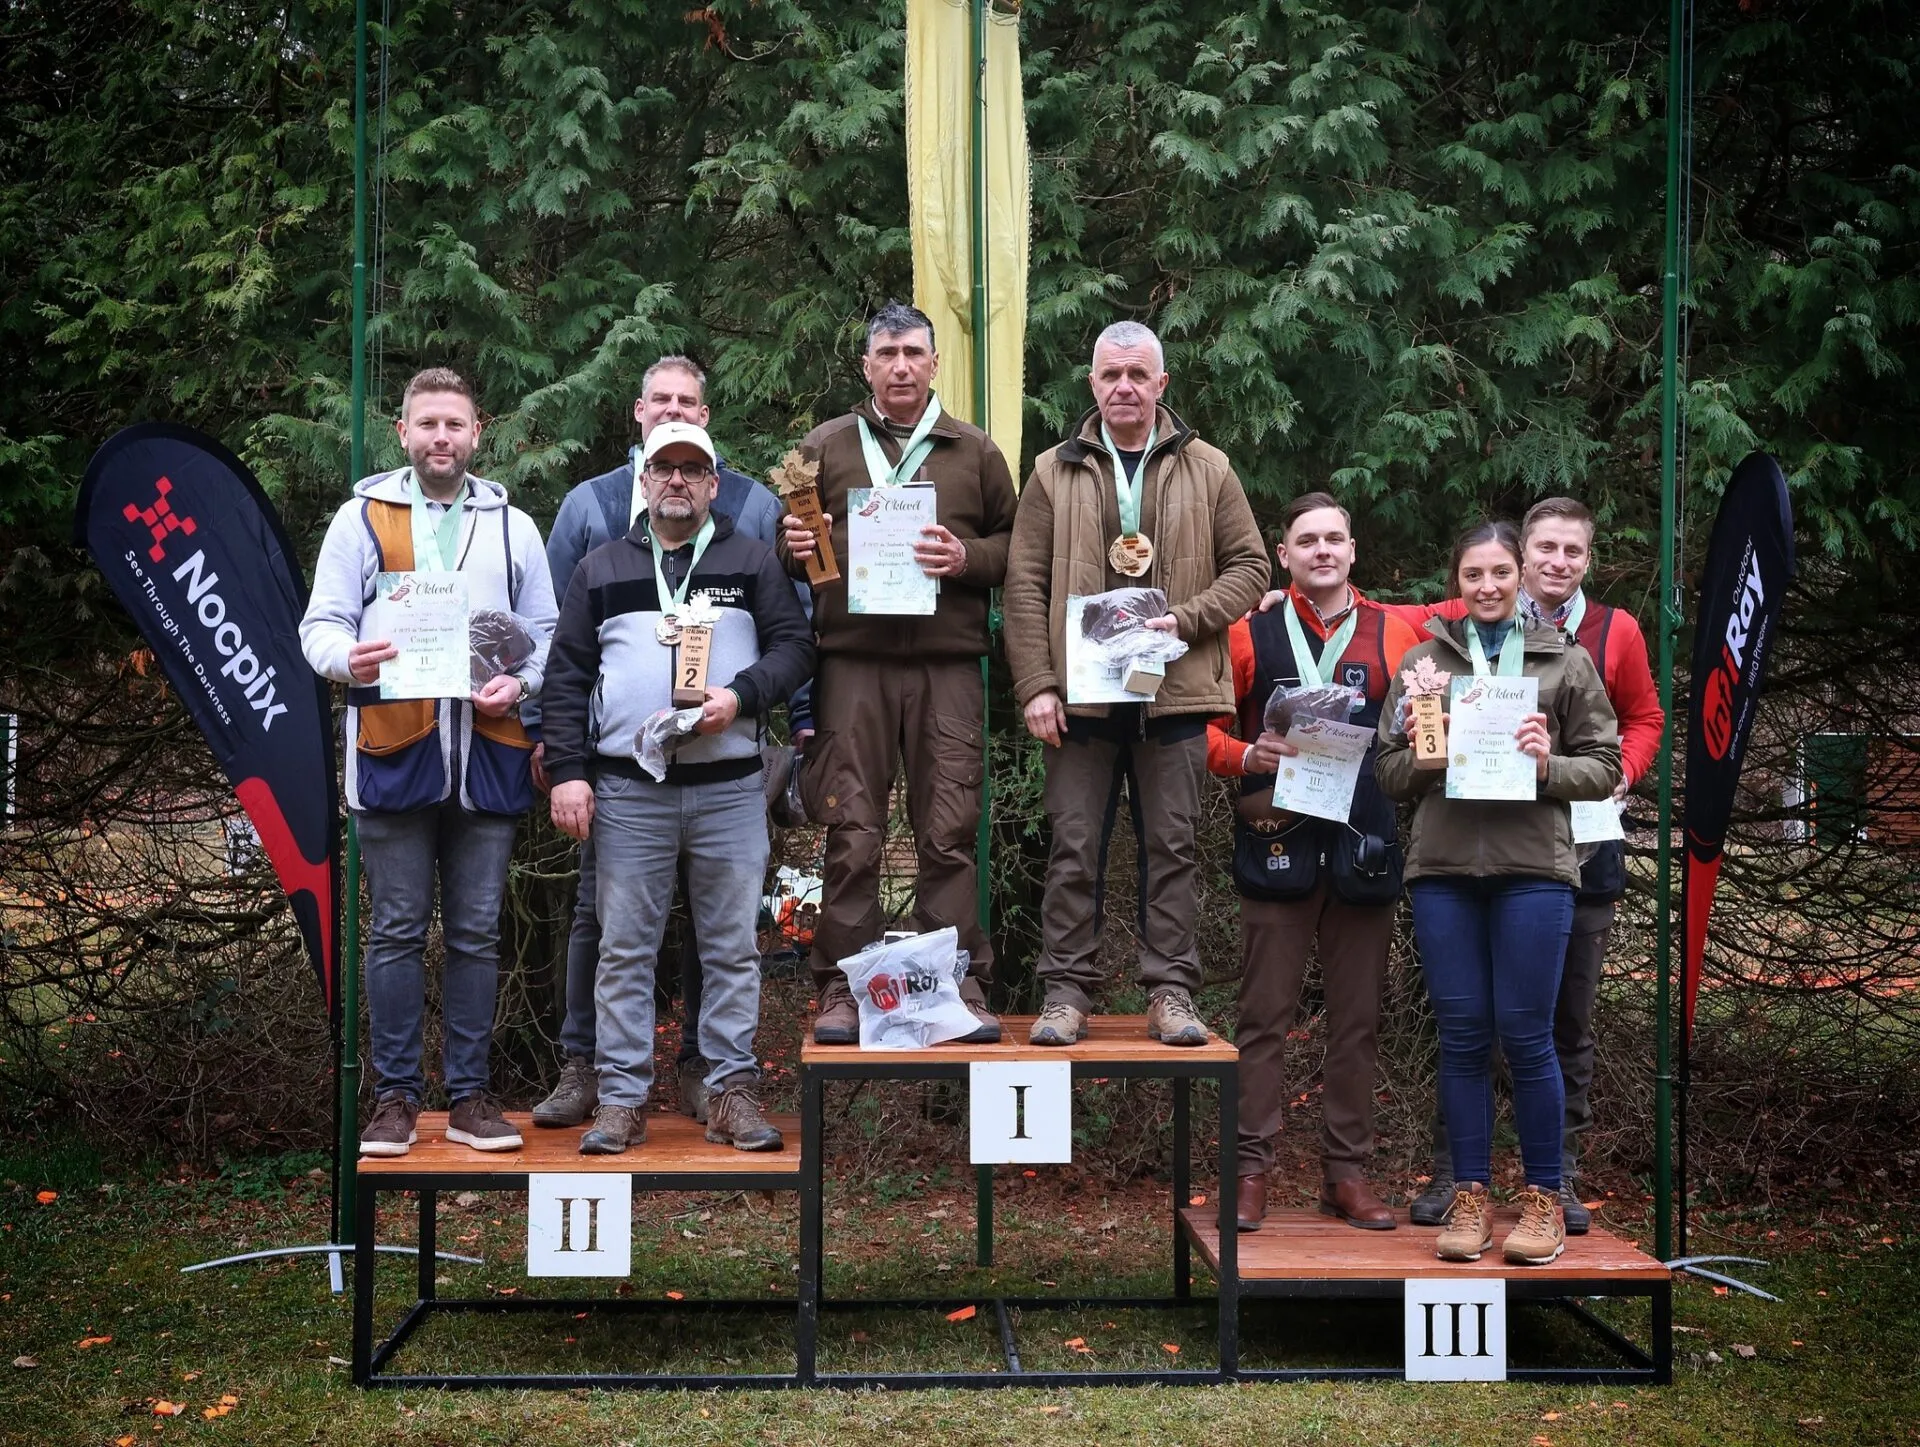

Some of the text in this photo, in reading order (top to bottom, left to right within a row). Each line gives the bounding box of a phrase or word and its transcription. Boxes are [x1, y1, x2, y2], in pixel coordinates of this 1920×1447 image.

[1733, 535, 1753, 605] Outdoor
[125, 550, 232, 725] See Through The Darkness
[172, 549, 288, 732] Nocpix
[1706, 549, 1764, 756] InfiRay
[684, 667, 698, 688] 2
[1748, 662, 1759, 688] Ultra
[1425, 734, 1437, 754] 3
[1267, 855, 1290, 870] GB
[1009, 1085, 1032, 1140] I
[554, 1198, 605, 1252] II
[1418, 1303, 1494, 1357] III
